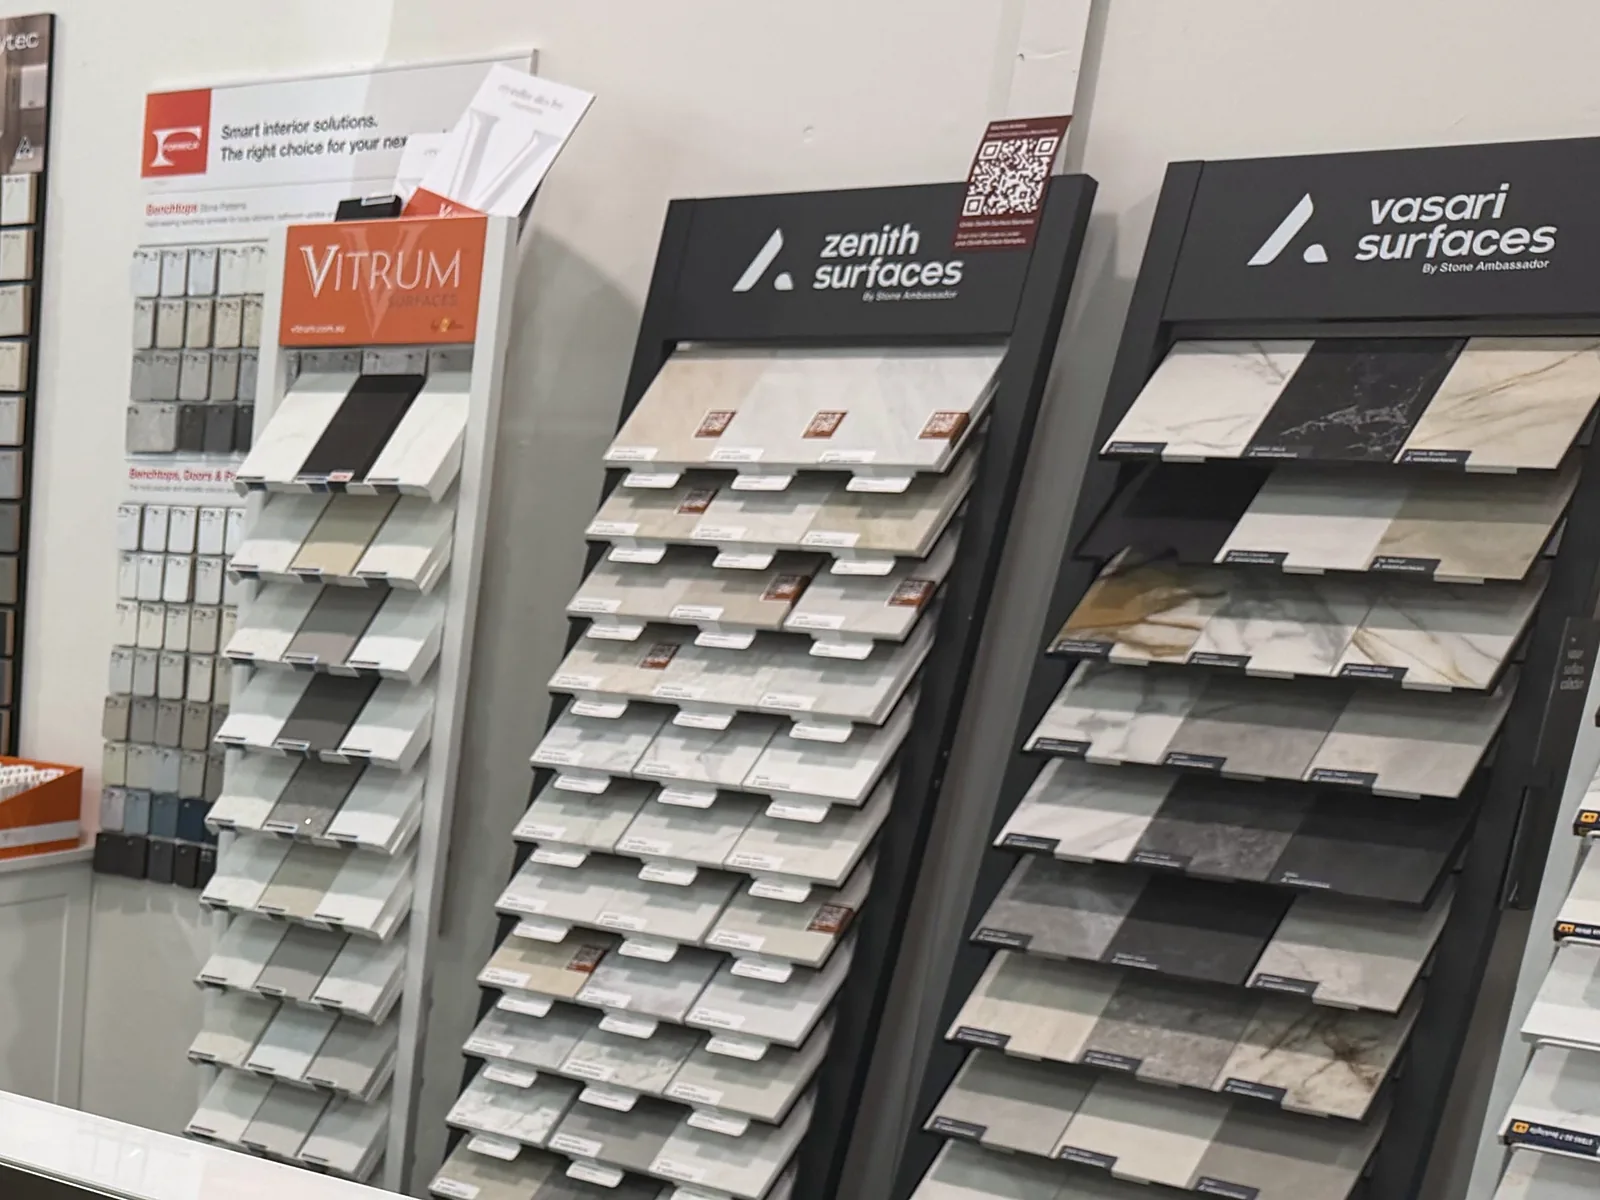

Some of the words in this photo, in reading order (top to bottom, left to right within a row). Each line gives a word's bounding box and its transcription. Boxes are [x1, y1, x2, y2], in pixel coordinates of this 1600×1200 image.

[221, 124, 260, 140] Smart
[263, 119, 310, 136] interior
[313, 114, 378, 133] solutions.
[220, 147, 243, 162] The
[246, 143, 277, 163] right
[279, 141, 324, 158] choice
[327, 139, 346, 154] for
[349, 138, 379, 155] your
[1371, 182, 1510, 225] vasari
[820, 223, 920, 258] zenith
[1354, 223, 1558, 261] surfaces
[812, 257, 965, 290] surfaces
[1422, 263, 1438, 275] By
[1440, 262, 1473, 273] Stone
[1475, 259, 1550, 271] Ambassador
[876, 291, 901, 301] Stone
